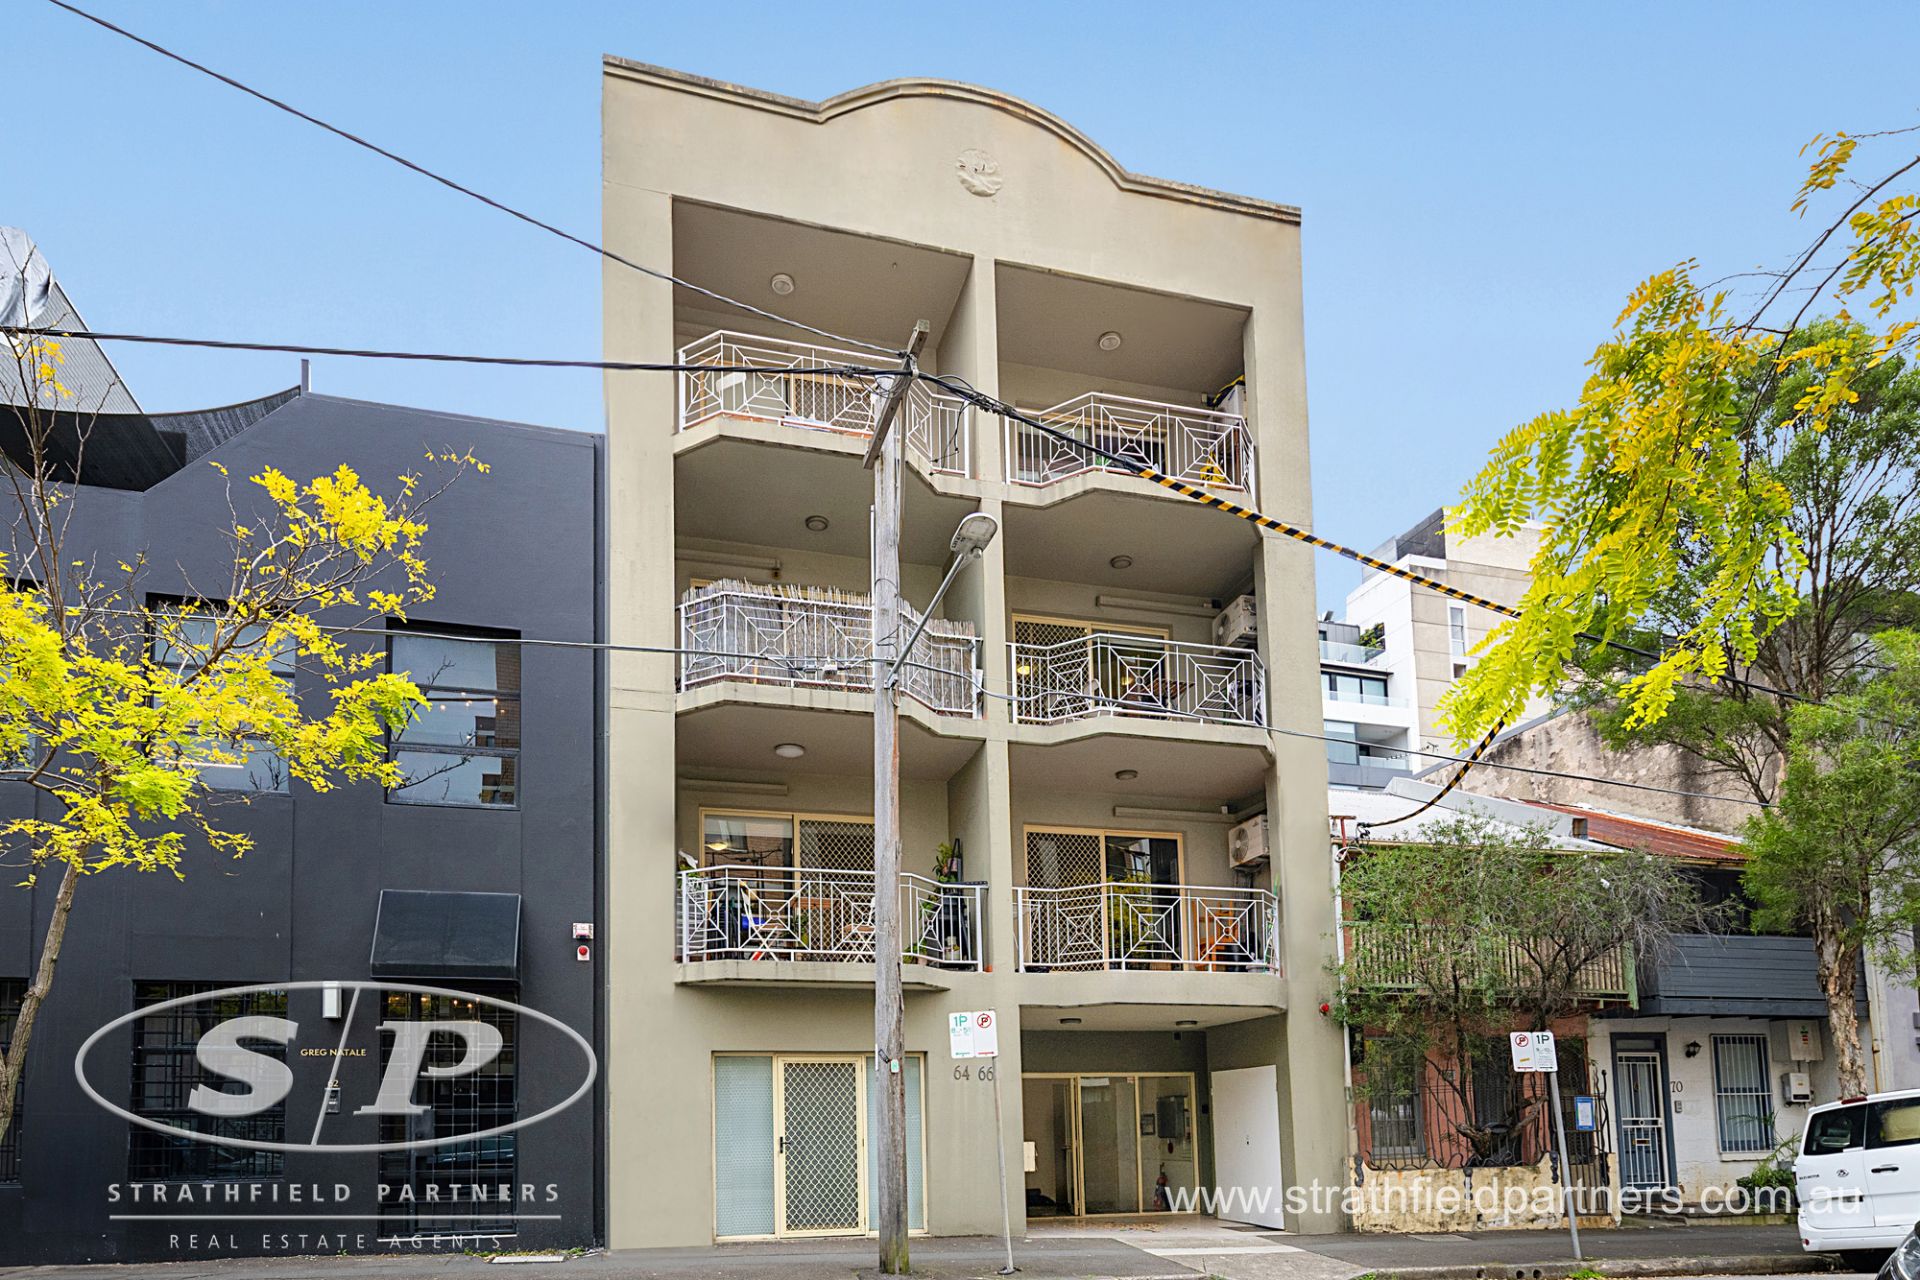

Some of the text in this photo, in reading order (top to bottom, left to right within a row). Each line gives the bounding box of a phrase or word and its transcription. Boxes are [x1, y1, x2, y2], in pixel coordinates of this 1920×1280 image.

[954, 1015, 968, 1026] 1P
[1536, 1034, 1550, 1045] 1P
[300, 1048, 366, 1056] GREG NATALE
[953, 1066, 994, 1081] 64 66
[1670, 1080, 1683, 1093] 70
